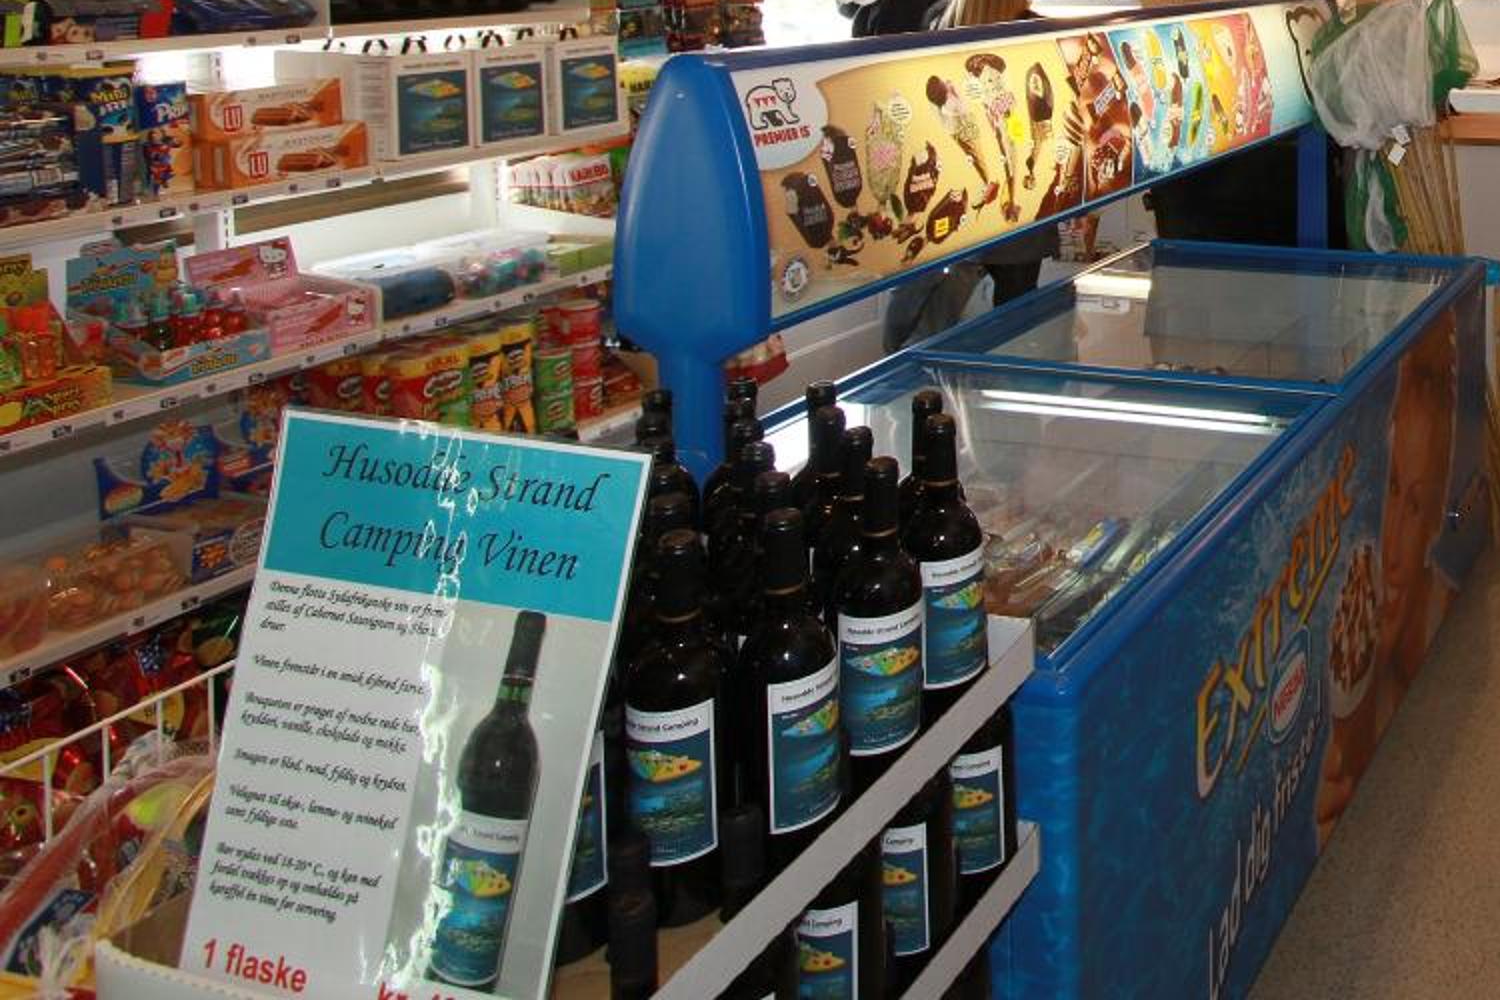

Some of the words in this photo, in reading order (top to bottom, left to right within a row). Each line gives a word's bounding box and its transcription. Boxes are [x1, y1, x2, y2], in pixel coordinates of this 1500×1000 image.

[754, 128, 800, 147] PREMIER
[800, 125, 811, 138] IS
[250, 154, 268, 177] LU
[479, 464, 610, 513] Strand
[320, 511, 466, 570] Camping
[477, 531, 580, 582] Vinen
[204, 939, 216, 968] 1
[225, 943, 306, 992] flaske
